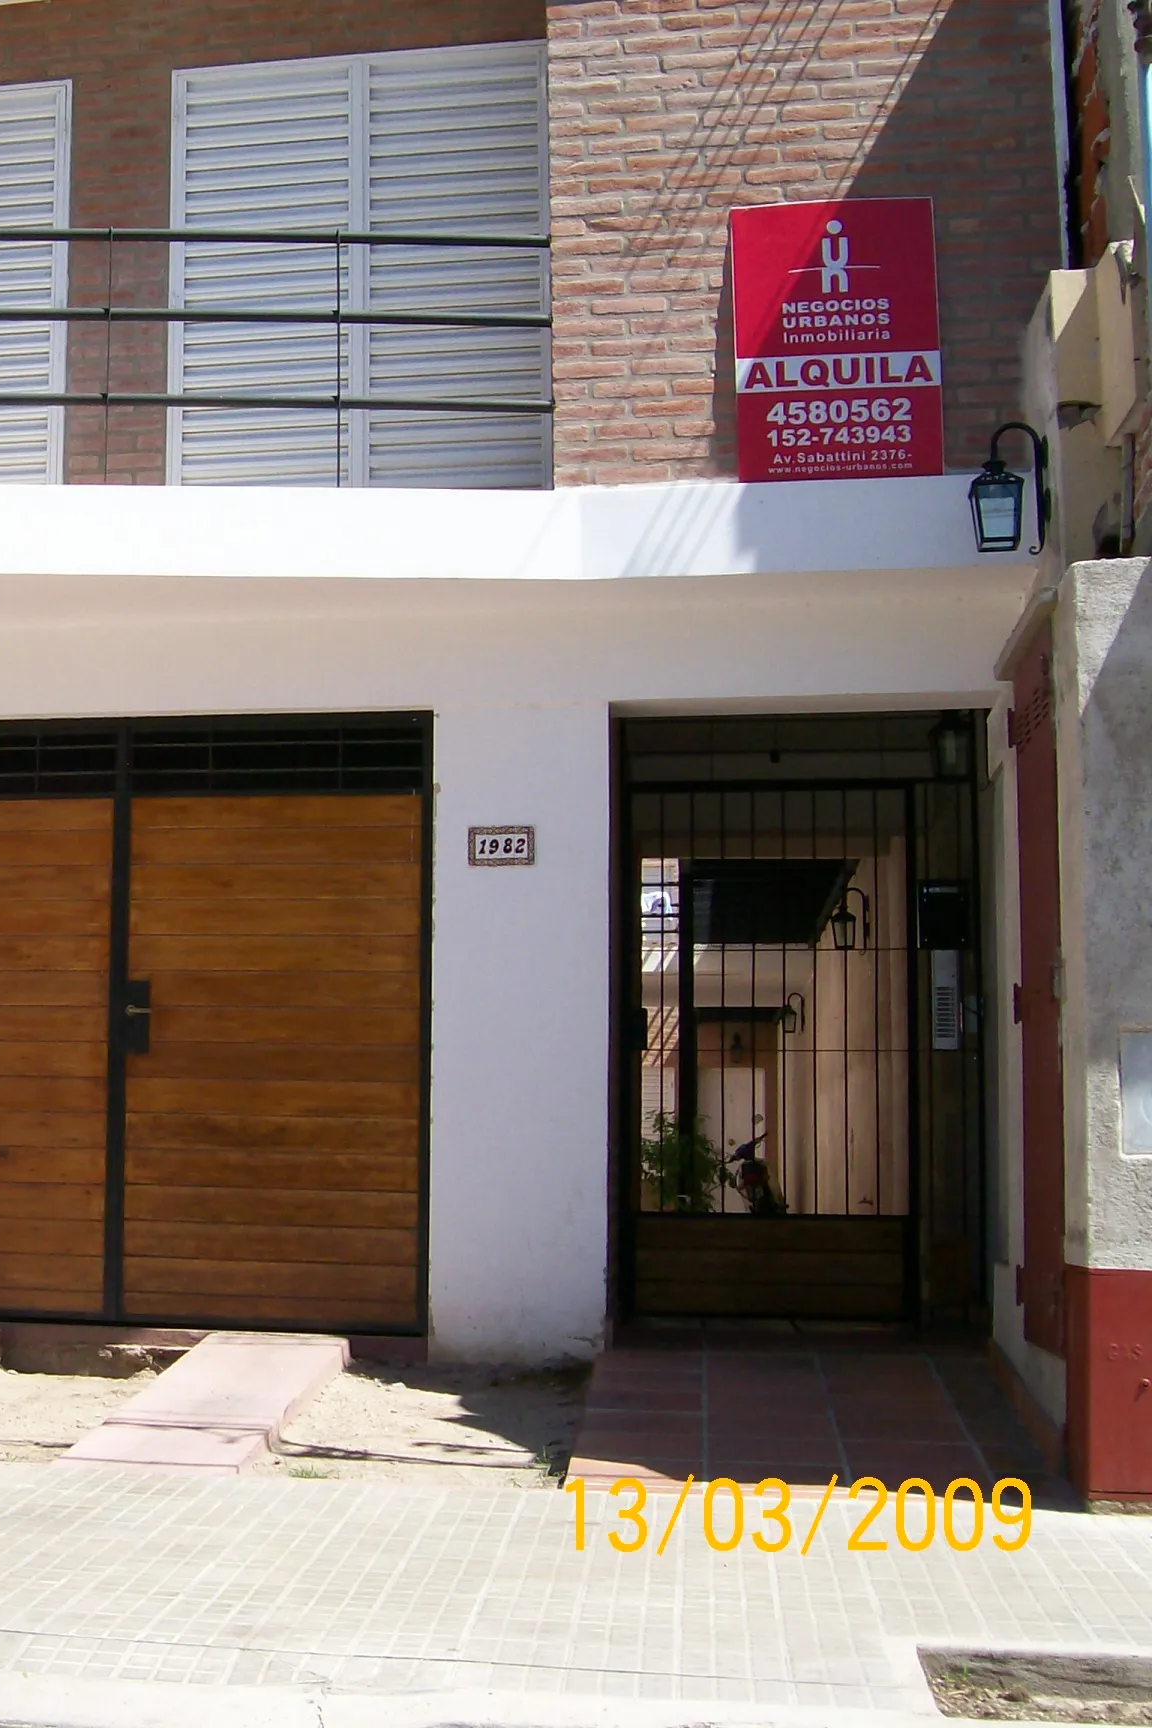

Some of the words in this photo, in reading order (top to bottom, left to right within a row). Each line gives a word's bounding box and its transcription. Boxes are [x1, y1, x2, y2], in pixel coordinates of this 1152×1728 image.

[782, 298, 890, 313] NEGOCIOS
[783, 313, 891, 329] URBANOS
[783, 328, 891, 344] Inmobiliaria
[744, 355, 934, 390] ALQUILA
[766, 397, 913, 426] 4580562
[766, 425, 912, 448] 152-743943
[768, 462, 914, 475] www.negocios-urbanos.com
[478, 837, 526, 855] 1982
